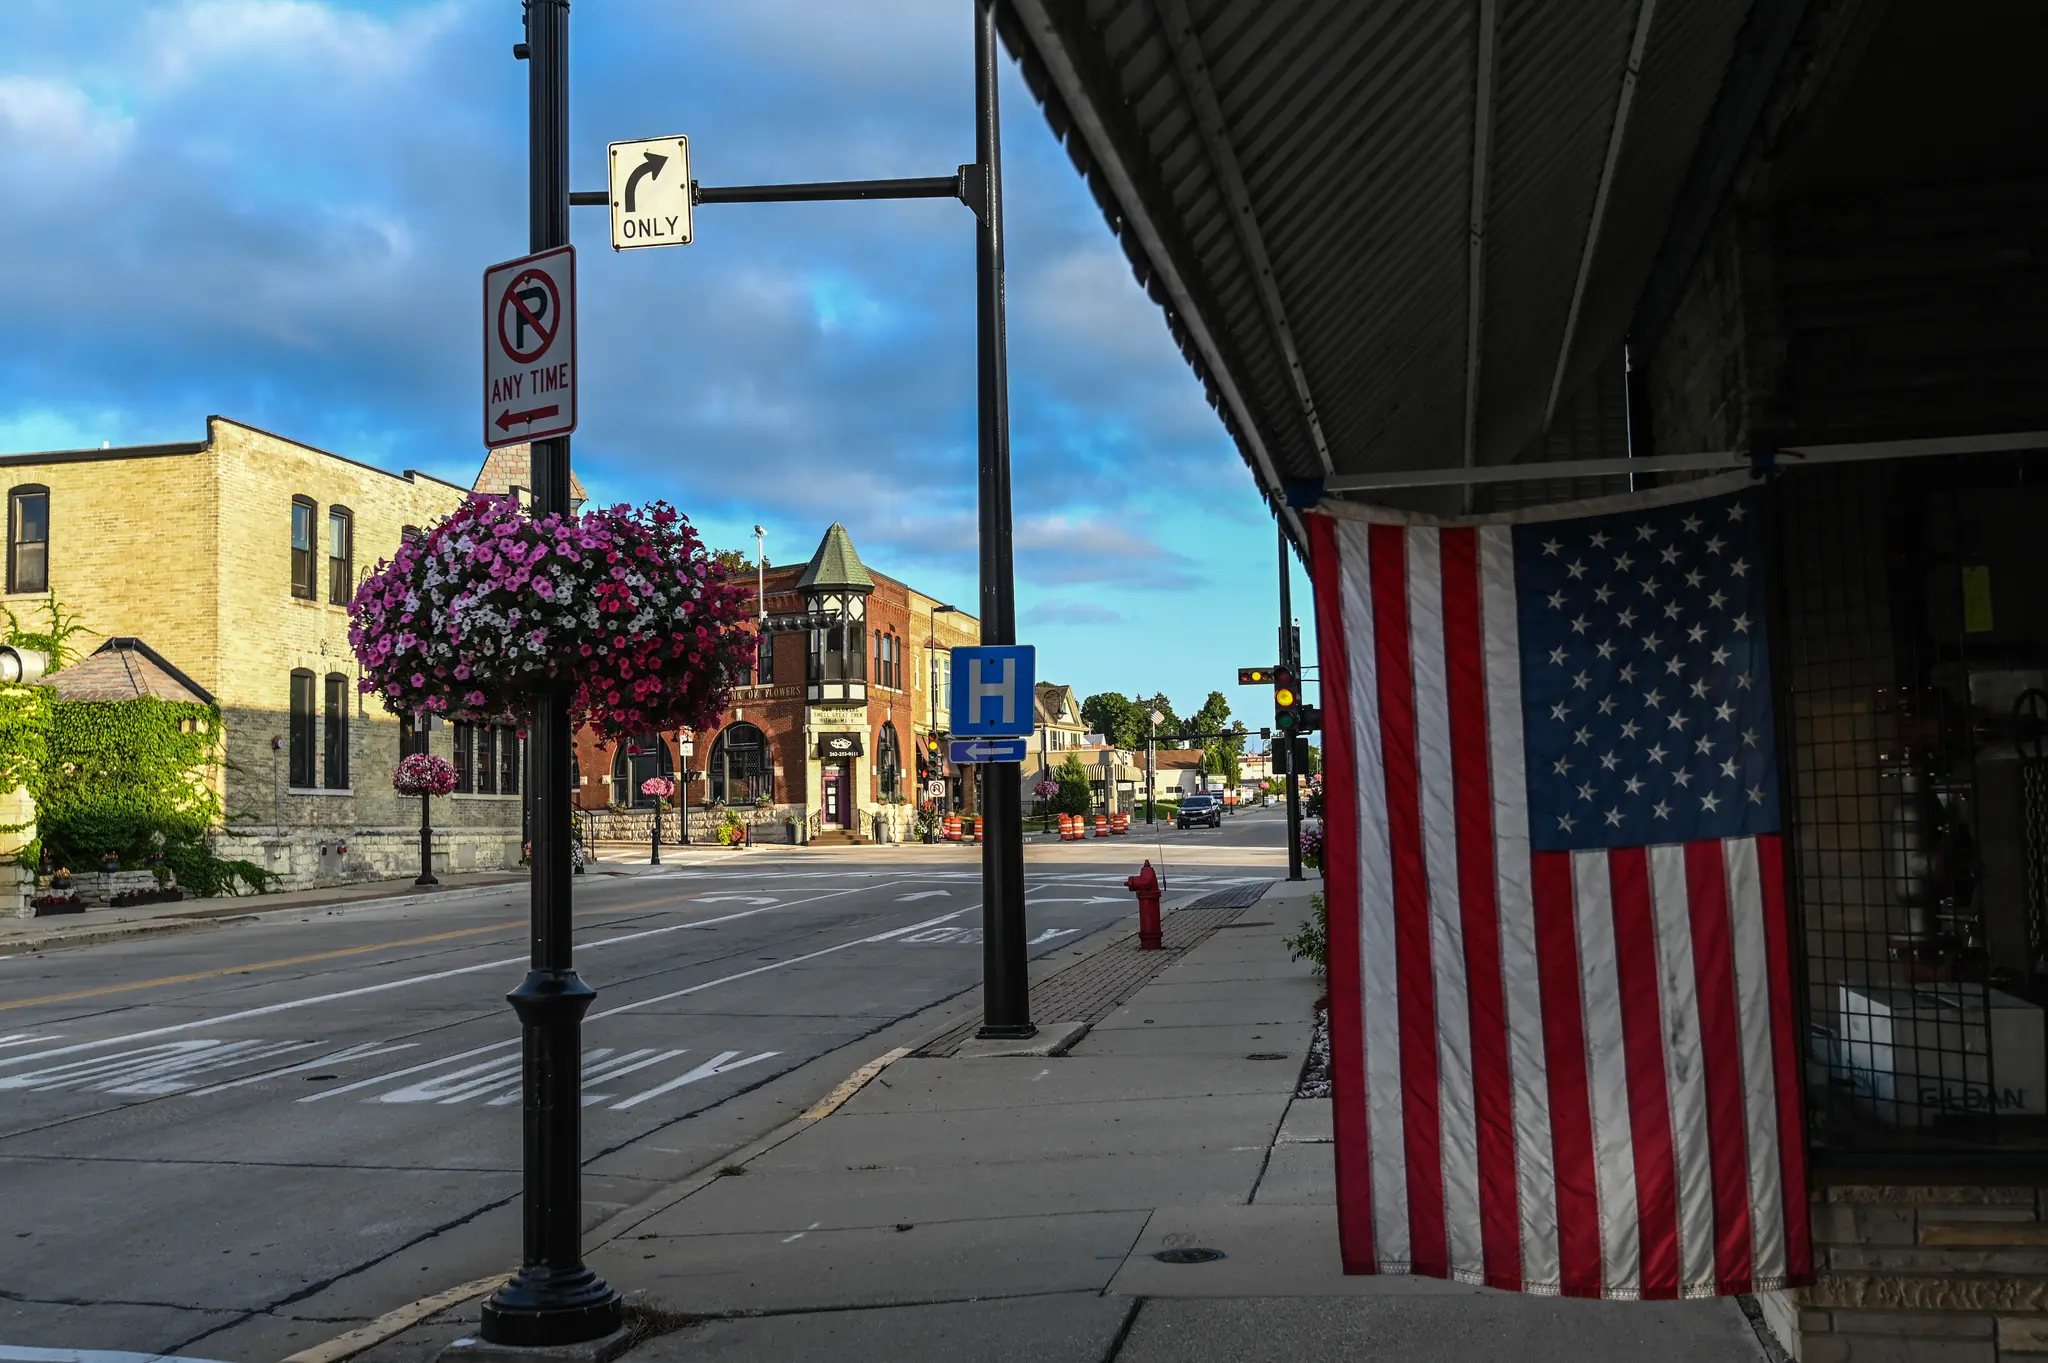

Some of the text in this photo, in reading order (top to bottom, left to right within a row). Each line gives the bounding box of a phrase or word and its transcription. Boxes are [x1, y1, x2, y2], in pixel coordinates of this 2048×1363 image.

[623, 216, 678, 239] ONLY
[516, 286, 548, 349] P
[492, 362, 569, 404] ANY TIME
[748, 689, 759, 699] OF
[765, 685, 801, 698] FLOWERS
[969, 658, 1016, 724] H
